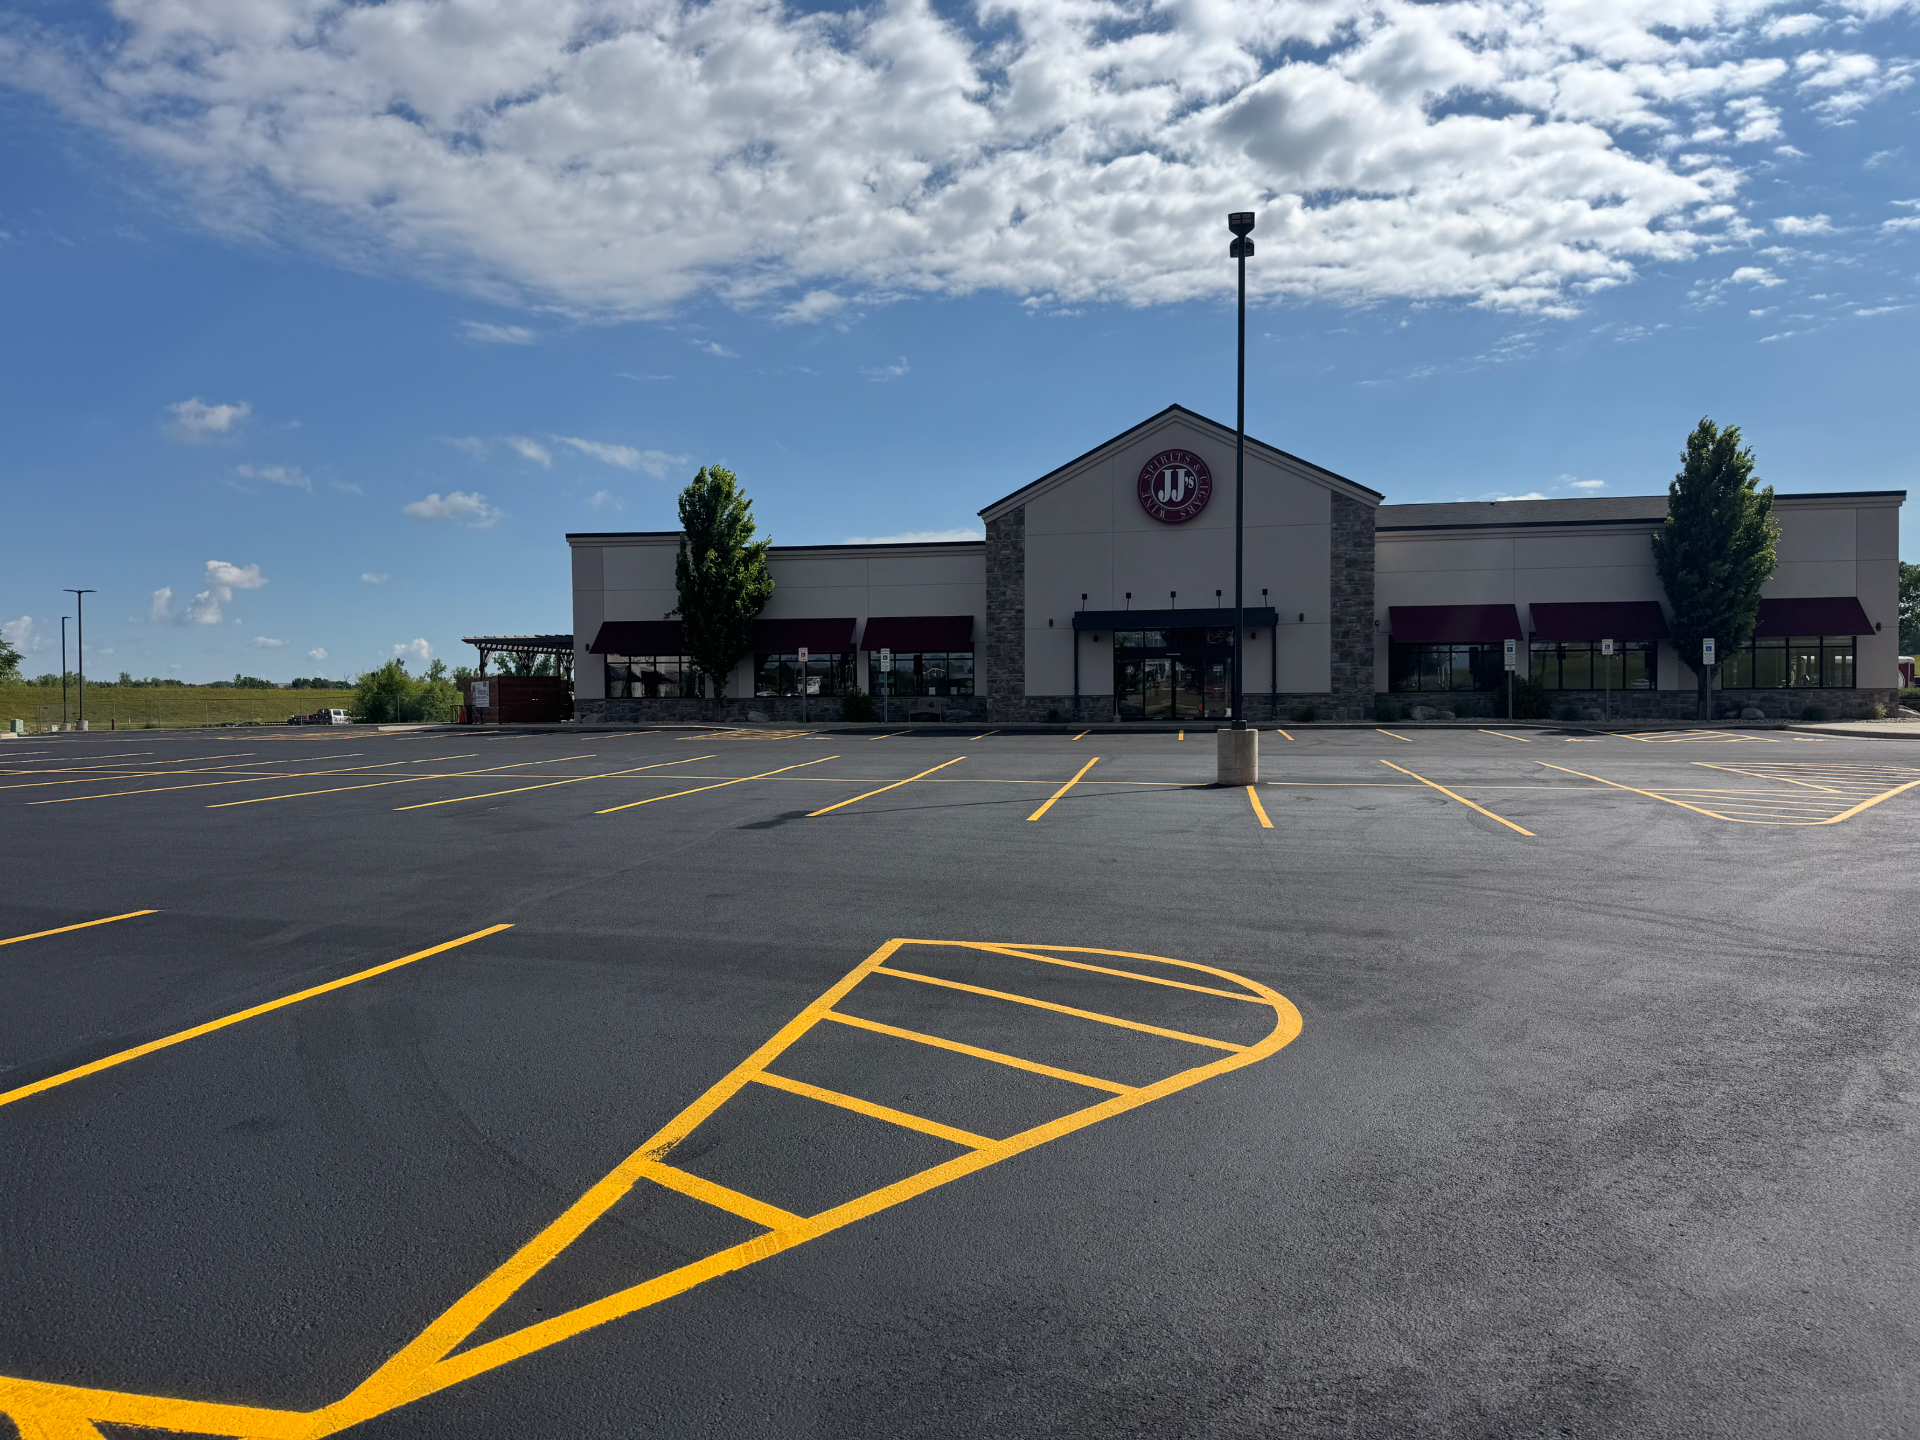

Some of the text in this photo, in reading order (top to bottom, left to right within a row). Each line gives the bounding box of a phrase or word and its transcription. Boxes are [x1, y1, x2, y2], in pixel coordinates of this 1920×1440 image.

[1144, 453, 1191, 480] SPIRITS
[1142, 490, 1165, 518] WINE
[1180, 476, 1208, 519] CIGARS
